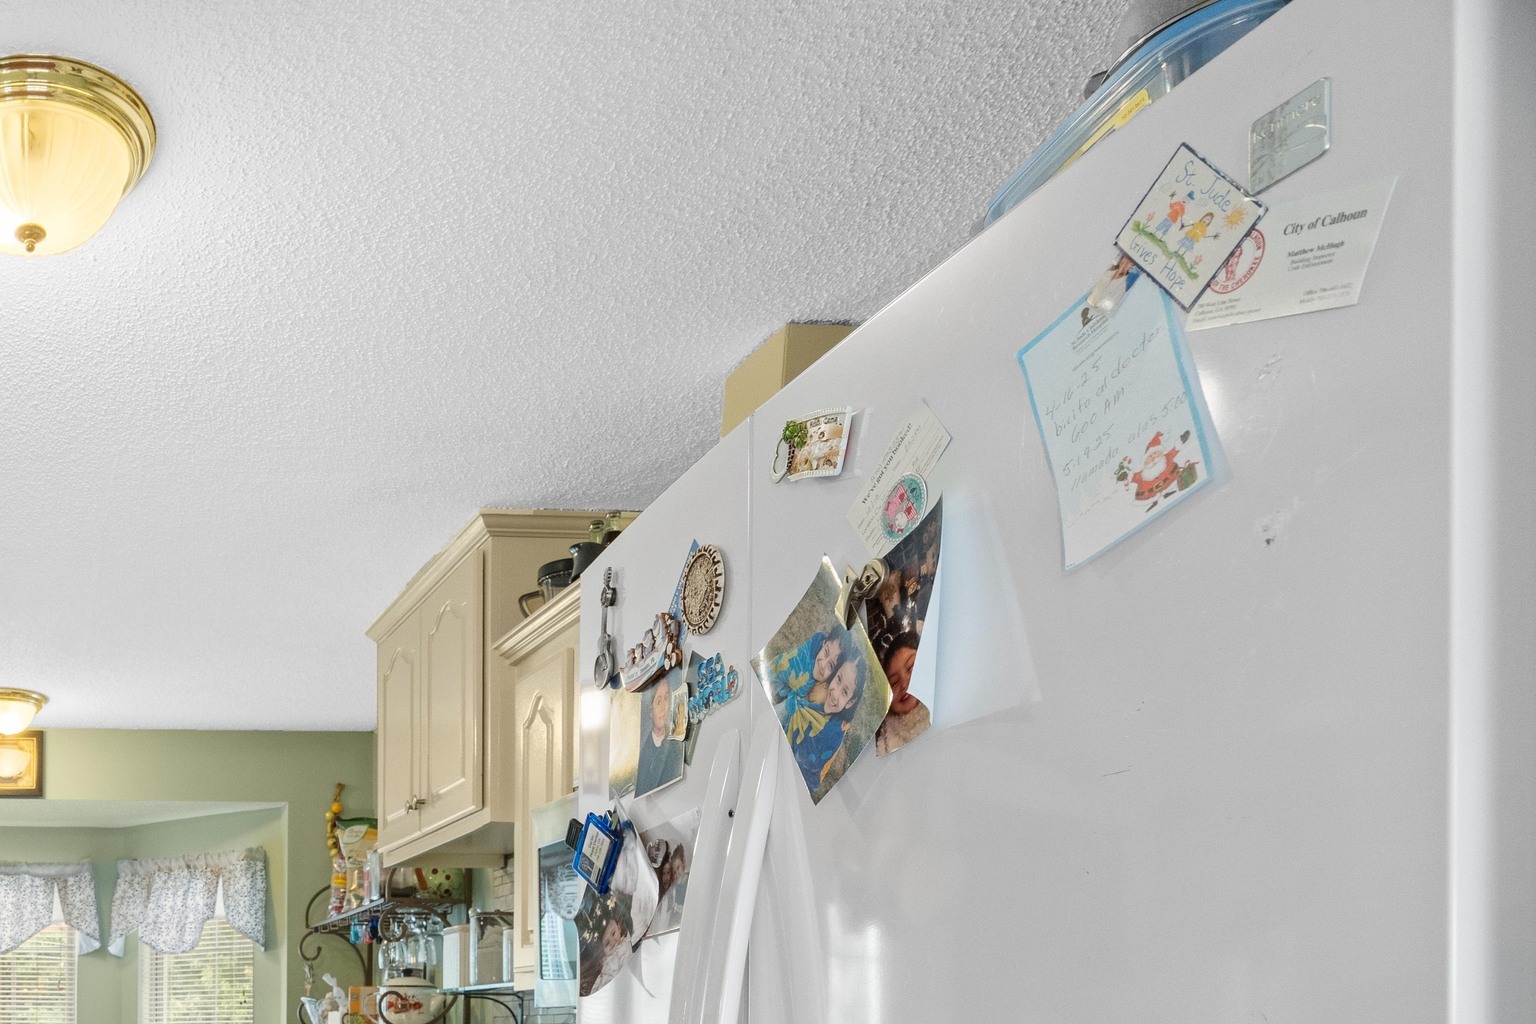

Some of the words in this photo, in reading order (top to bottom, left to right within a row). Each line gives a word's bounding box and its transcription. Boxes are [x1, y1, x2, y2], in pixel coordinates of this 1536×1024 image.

[1175, 160, 1196, 187] St.
[1200, 176, 1231, 213] Jude
[1283, 223, 1305, 236] City
[1307, 217, 1321, 231] of
[1322, 209, 1368, 227] Calhoun
[1129, 233, 1158, 266] Gives
